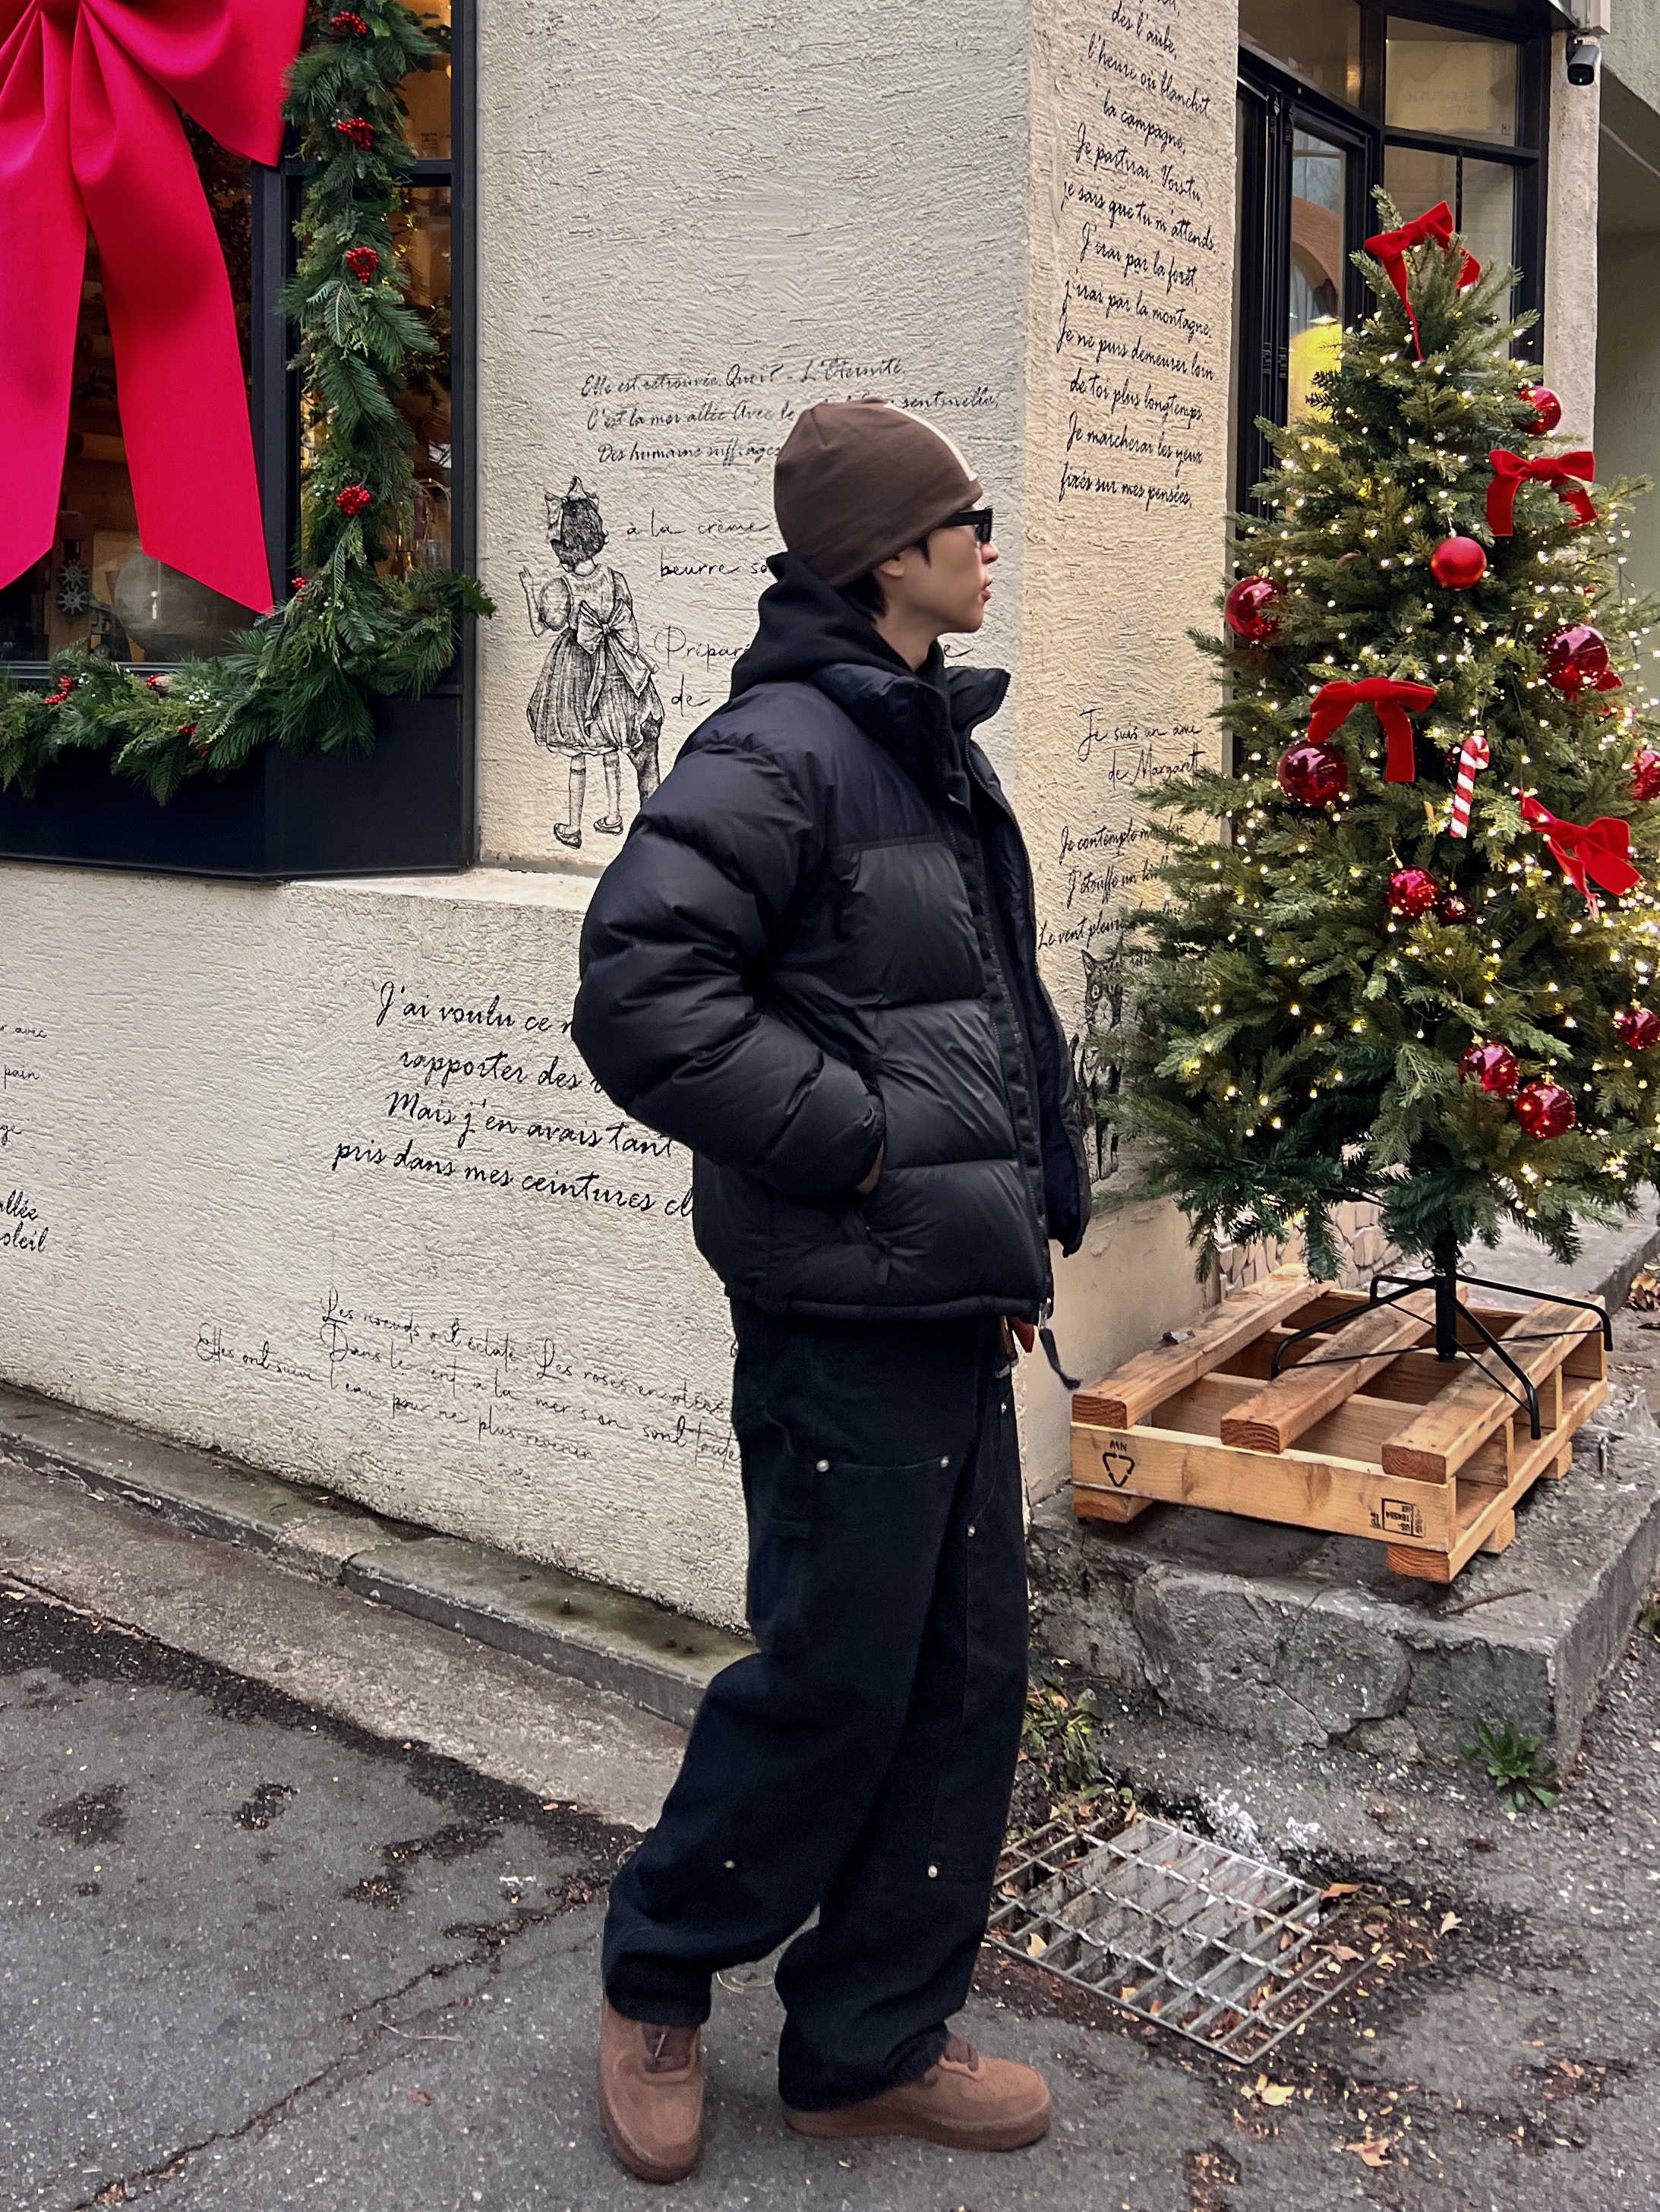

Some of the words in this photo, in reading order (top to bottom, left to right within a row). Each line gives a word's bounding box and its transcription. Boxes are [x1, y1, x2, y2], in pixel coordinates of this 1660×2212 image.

[1088, 32, 1137, 80] l'heure
[1161, 69, 1210, 116] blanchit
[1103, 89, 1116, 117] la
[1076, 122, 1092, 163] Je
[1061, 181, 1075, 210] je
[1078, 186, 1106, 209] sais
[1109, 200, 1134, 229] que
[1135, 200, 1152, 226] tu
[1124, 253, 1149, 279] par
[1153, 250, 1165, 276] la
[1106, 294, 1131, 319] par
[1136, 289, 1148, 316] la
[1056, 312, 1073, 353] Je
[1077, 334, 1095, 348] ne
[1096, 339, 1128, 364] puis
[1131, 336, 1187, 374] demeurer
[1191, 351, 1214, 380] loin
[581, 374, 611, 396] Elle
[617, 375, 640, 393] est
[1070, 367, 1087, 393] de
[1089, 373, 1109, 399] toi
[1111, 378, 1141, 415] plus
[587, 408, 626, 430] C'est
[630, 408, 645, 426] la
[651, 413, 680, 426] mer
[781, 401, 795, 421] le
[630, 441, 702, 461] humains
[1066, 411, 1083, 452] Je
[1087, 424, 1153, 453] marcherai
[1158, 431, 1172, 459] les
[1175, 448, 1204, 478] yeux
[1059, 460, 1092, 502] fixés
[1095, 478, 1117, 494] sur
[1122, 483, 1145, 497] mes
[626, 522, 637, 535] à
[652, 508, 685, 537] la
[698, 519, 770, 534] crème
[661, 551, 740, 577] beurre
[671, 674, 711, 717] de
[1078, 708, 1108, 762] Je
[1114, 722, 1138, 740] suis
[1145, 728, 1167, 737] un
[1173, 724, 1202, 735] ami
[1108, 749, 1129, 790] de
[1059, 825, 1074, 865] Je
[1078, 817, 1137, 855] contemple
[1038, 920, 1056, 949] Le
[1059, 916, 1088, 944] vent
[377, 980, 430, 1027] J'ai
[440, 995, 516, 1027] voulu
[524, 1015, 552, 1031] ce
[15, 1027, 47, 1039] avec
[399, 1051, 527, 1088] rapporter
[537, 1056, 583, 1091] des
[385, 1091, 456, 1125] Mais
[458, 1098, 517, 1147] j'en
[527, 1120, 602, 1147] avais
[606, 1122, 674, 1157] tant
[331, 1139, 386, 1170] pris
[393, 1139, 456, 1175] dans
[465, 1163, 514, 1187] mes
[522, 1169, 655, 1210] ceintures
[664, 1187, 693, 1217] cl
[0, 1221, 49, 1252] oleil
[196, 1322, 234, 1363] Elles
[243, 1340, 278, 1369] ont
[478, 1405, 515, 1444] plus
[320, 1323, 380, 1362] Dans
[495, 1368, 521, 1400] la
[536, 1397, 571, 1413] mer
[535, 1339, 572, 1381] Les
[584, 1371, 627, 1390] roses
